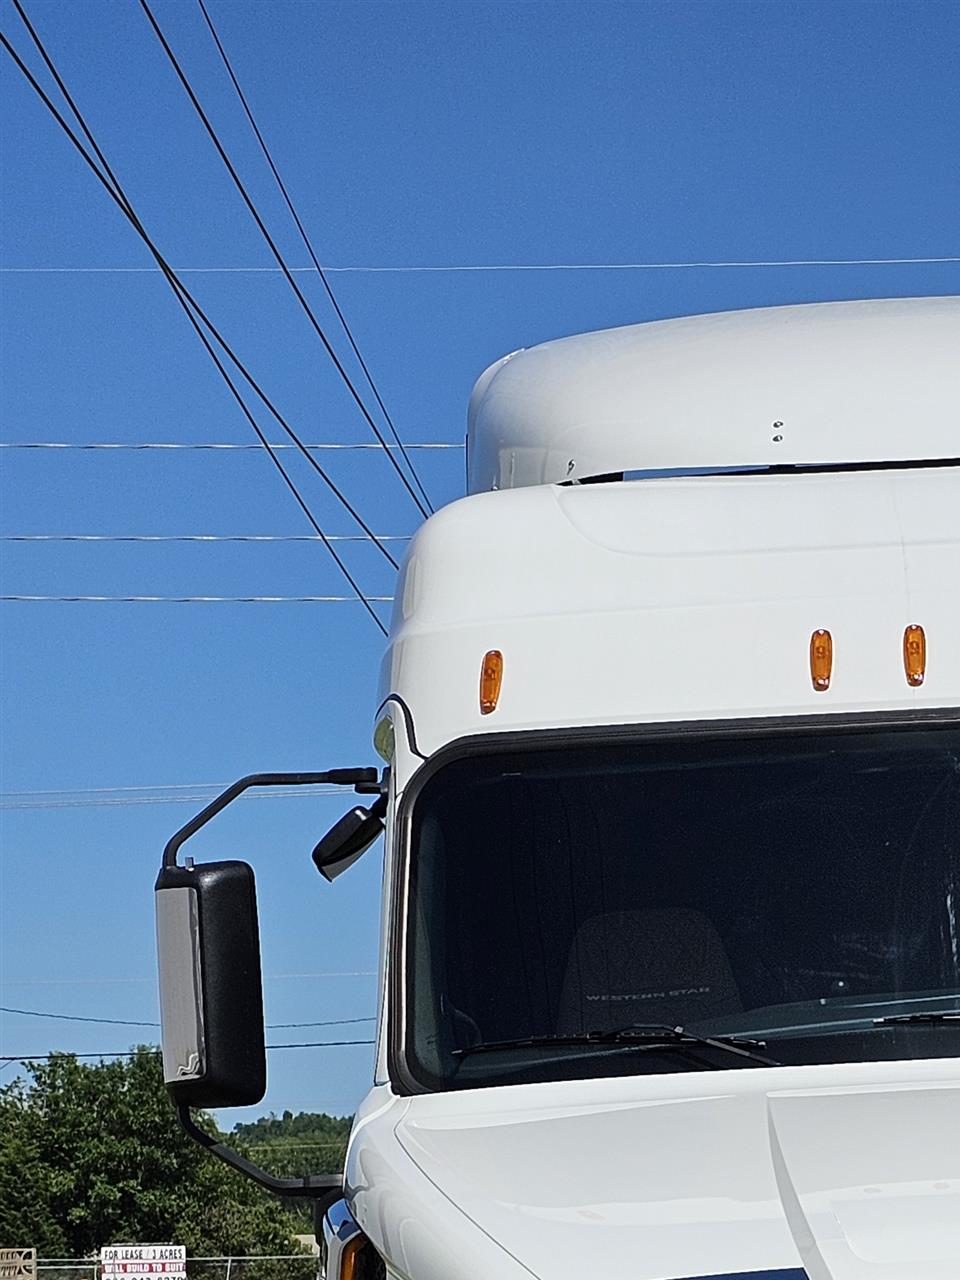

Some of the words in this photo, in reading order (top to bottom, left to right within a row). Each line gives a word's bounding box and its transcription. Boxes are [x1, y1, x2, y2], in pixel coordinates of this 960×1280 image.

[669, 987, 709, 995] STAR
[105, 1250, 118, 1259] FOR
[122, 1249, 143, 1259] LEASE
[160, 1249, 182, 1259] ACRES
[105, 1264, 124, 1273] WILL
[127, 1264, 149, 1273] BUILD
[152, 1264, 162, 1273] TO
